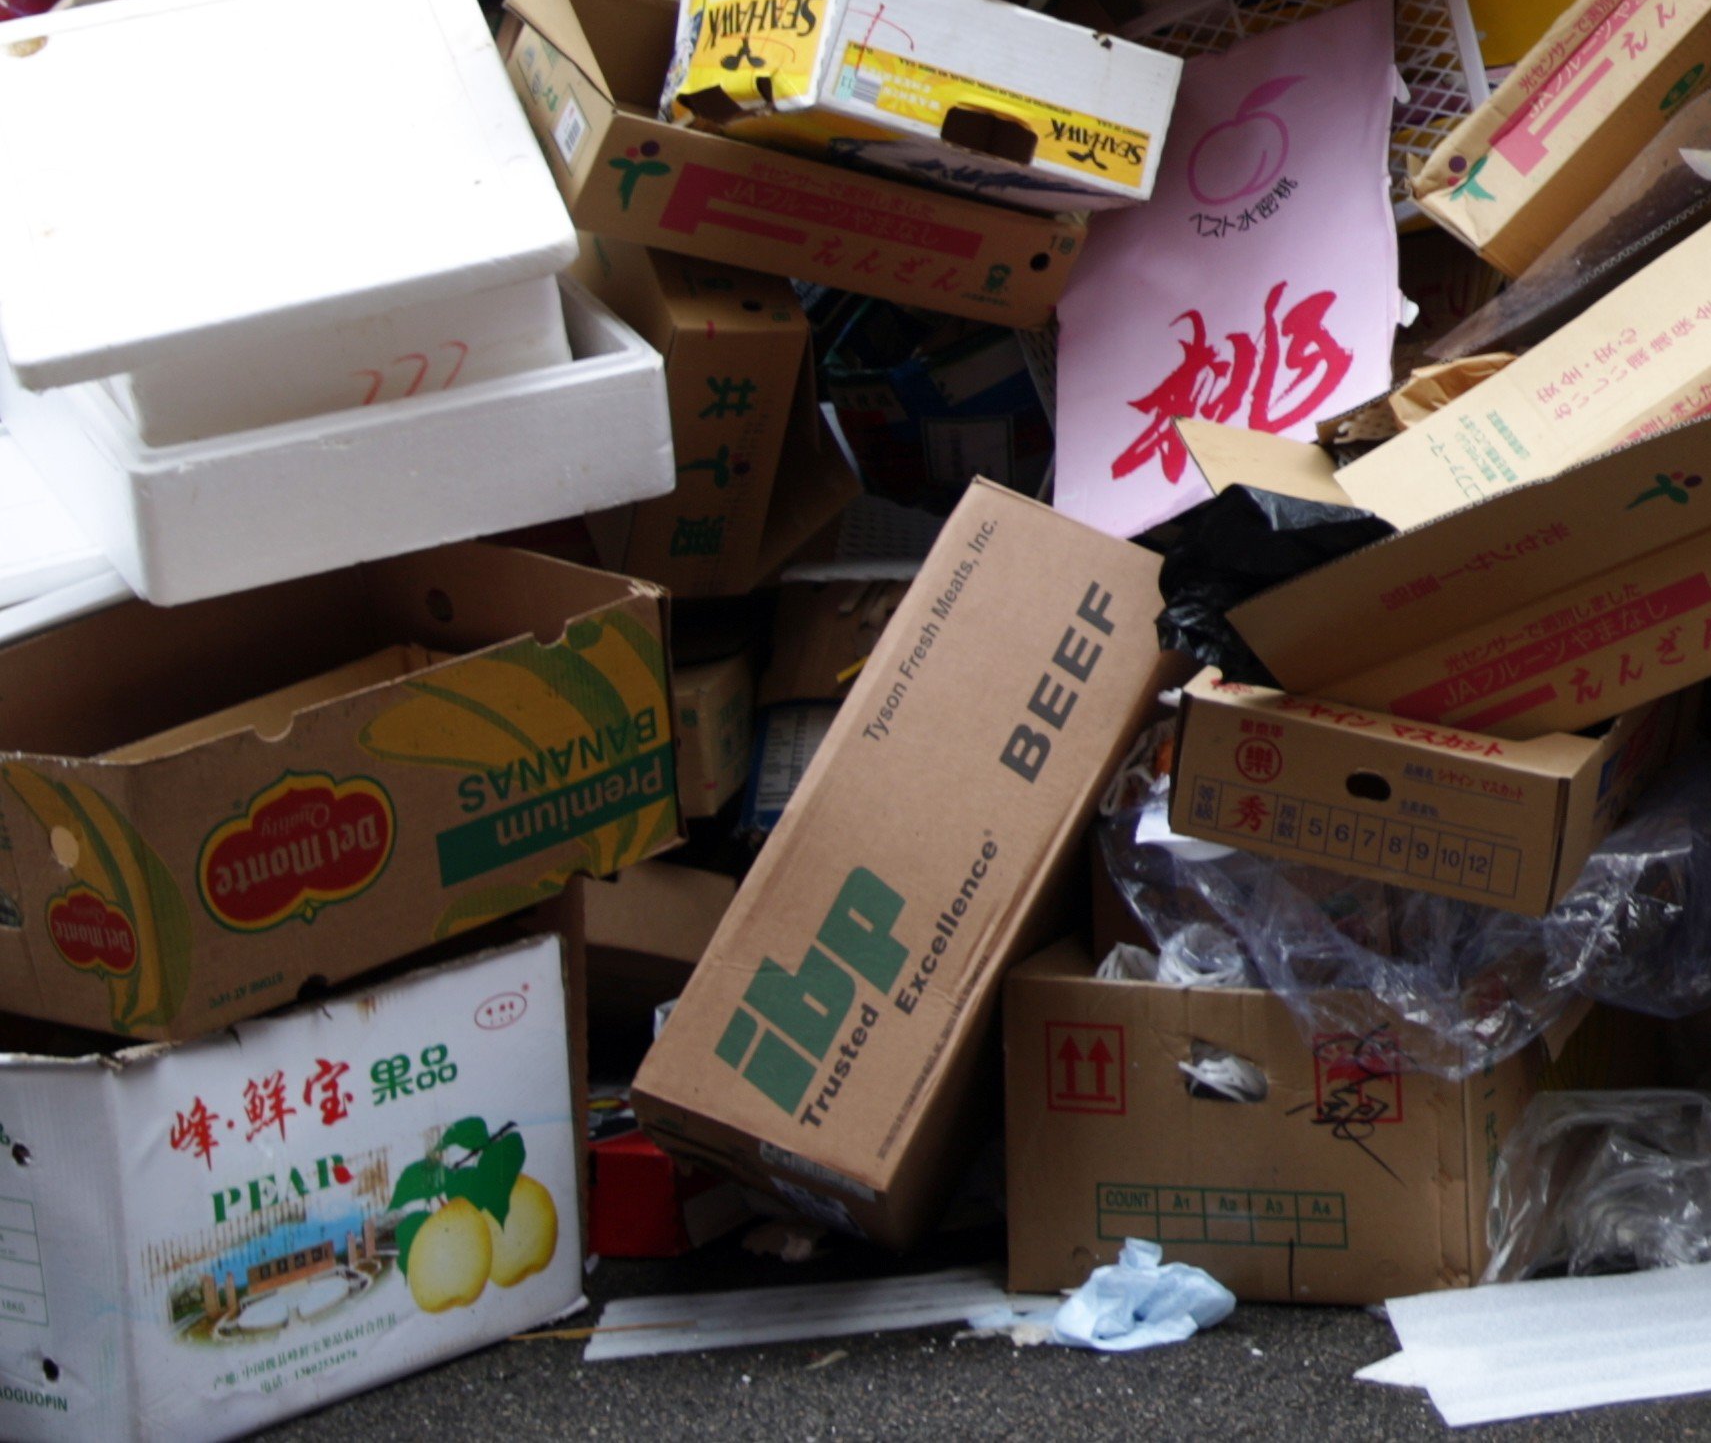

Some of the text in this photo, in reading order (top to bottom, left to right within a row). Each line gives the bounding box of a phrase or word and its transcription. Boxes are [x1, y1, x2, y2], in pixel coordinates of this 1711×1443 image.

[1044, 117, 1151, 167] SEAHAWK
[722, 179, 941, 249] JAフルーツやまなし
[812, 235, 962, 296] えんざん
[1535, 326, 1640, 406] 安全・安心
[861, 515, 1000, 742] Tyson Fresh Meats, Inc.
[1439, 591, 1672, 709] JAフルーツやまなし
[999, 579, 1118, 785] BEEF
[457, 706, 658, 816] BANANAS
[257, 799, 332, 839] Quality
[496, 756, 664, 848] Premium
[1229, 793, 1489, 874] 秀 5 6 7 8 9 10 12
[213, 811, 381, 900] Del Monte
[52, 916, 131, 954] Del Monte
[713, 865, 907, 1116] ibp
[800, 1003, 879, 1130] Trusted
[894, 837, 999, 1016] Excellence
[369, 1044, 459, 1106] 果品
[210, 1153, 348, 1224] PEAR
[1104, 1187, 1153, 1213] COUNT
